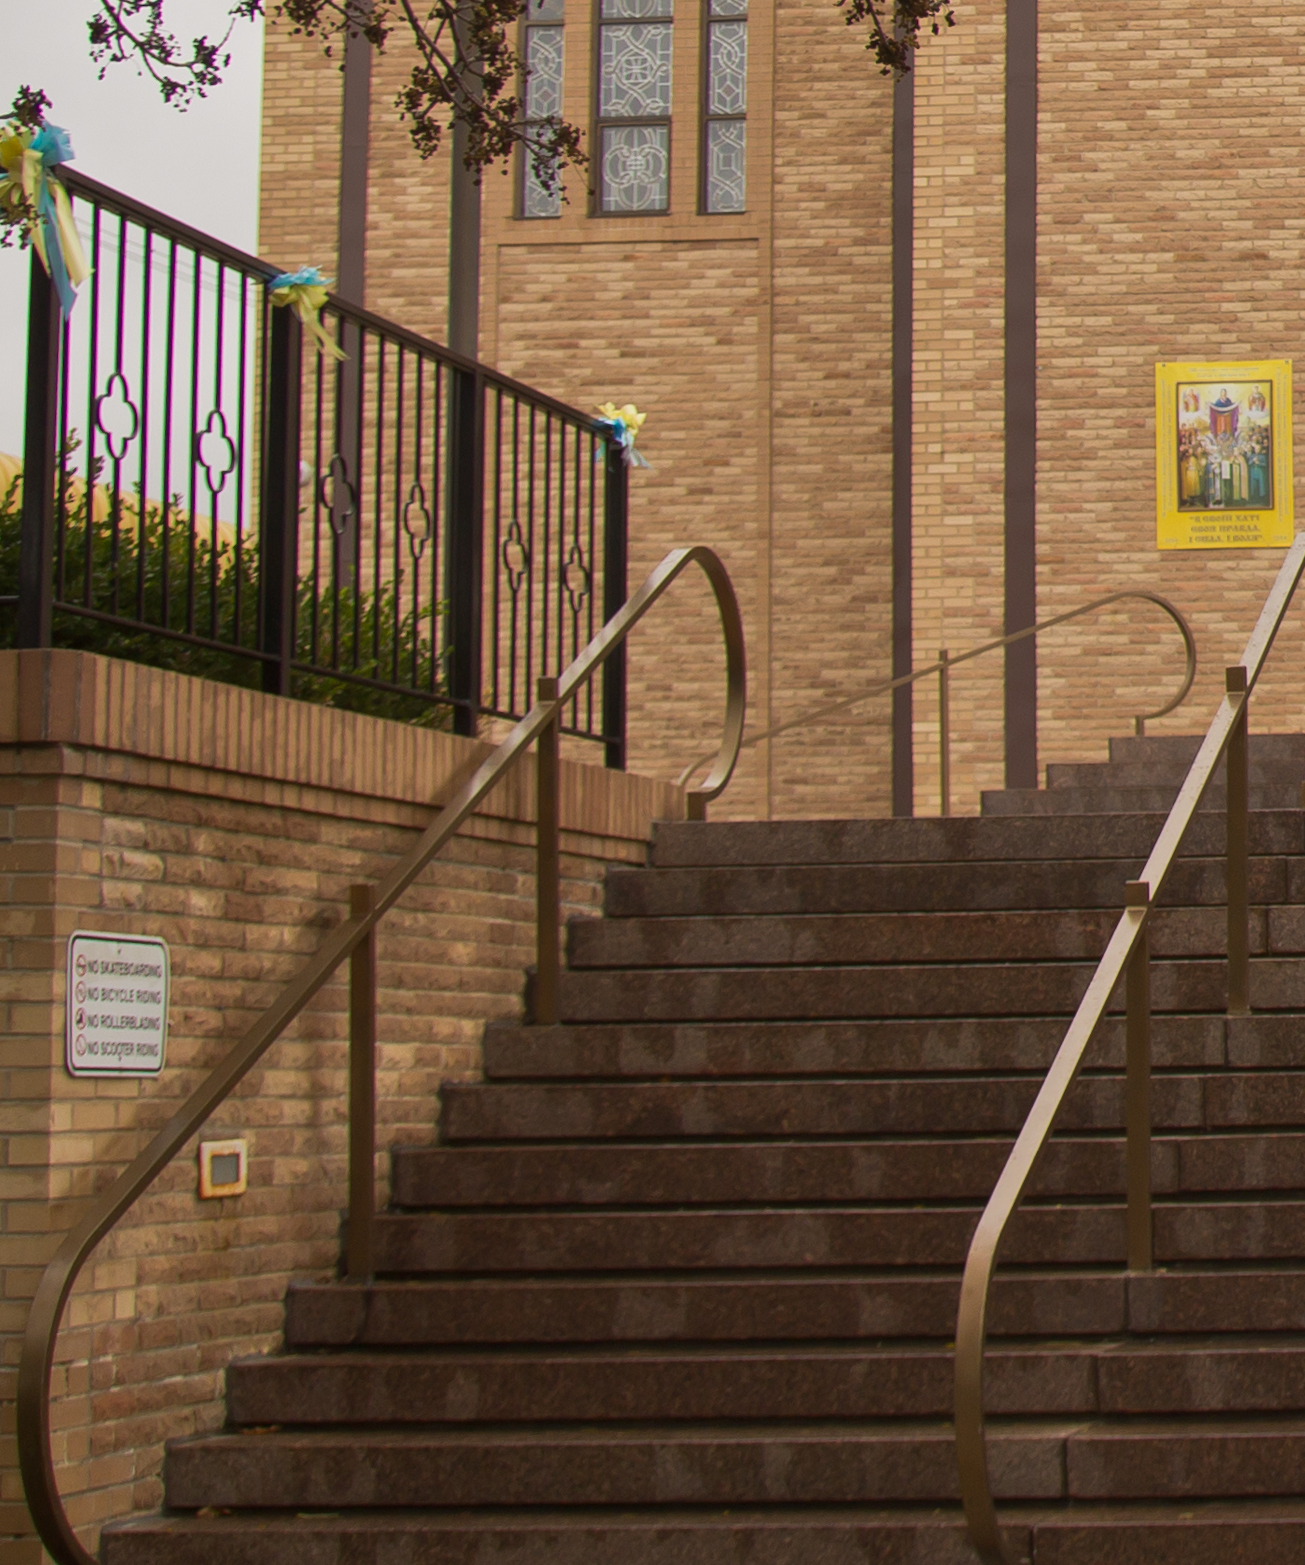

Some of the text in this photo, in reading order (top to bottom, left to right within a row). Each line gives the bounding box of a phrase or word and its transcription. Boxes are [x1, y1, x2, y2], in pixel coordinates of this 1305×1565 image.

[87, 959, 162, 979] NO SKATEBOARDING
[87, 987, 162, 1005] NO BICYCLE RIDING
[87, 1014, 161, 1032] NO ROLLERBLADING
[87, 1041, 160, 1057] NO SCOOTER RIDING
